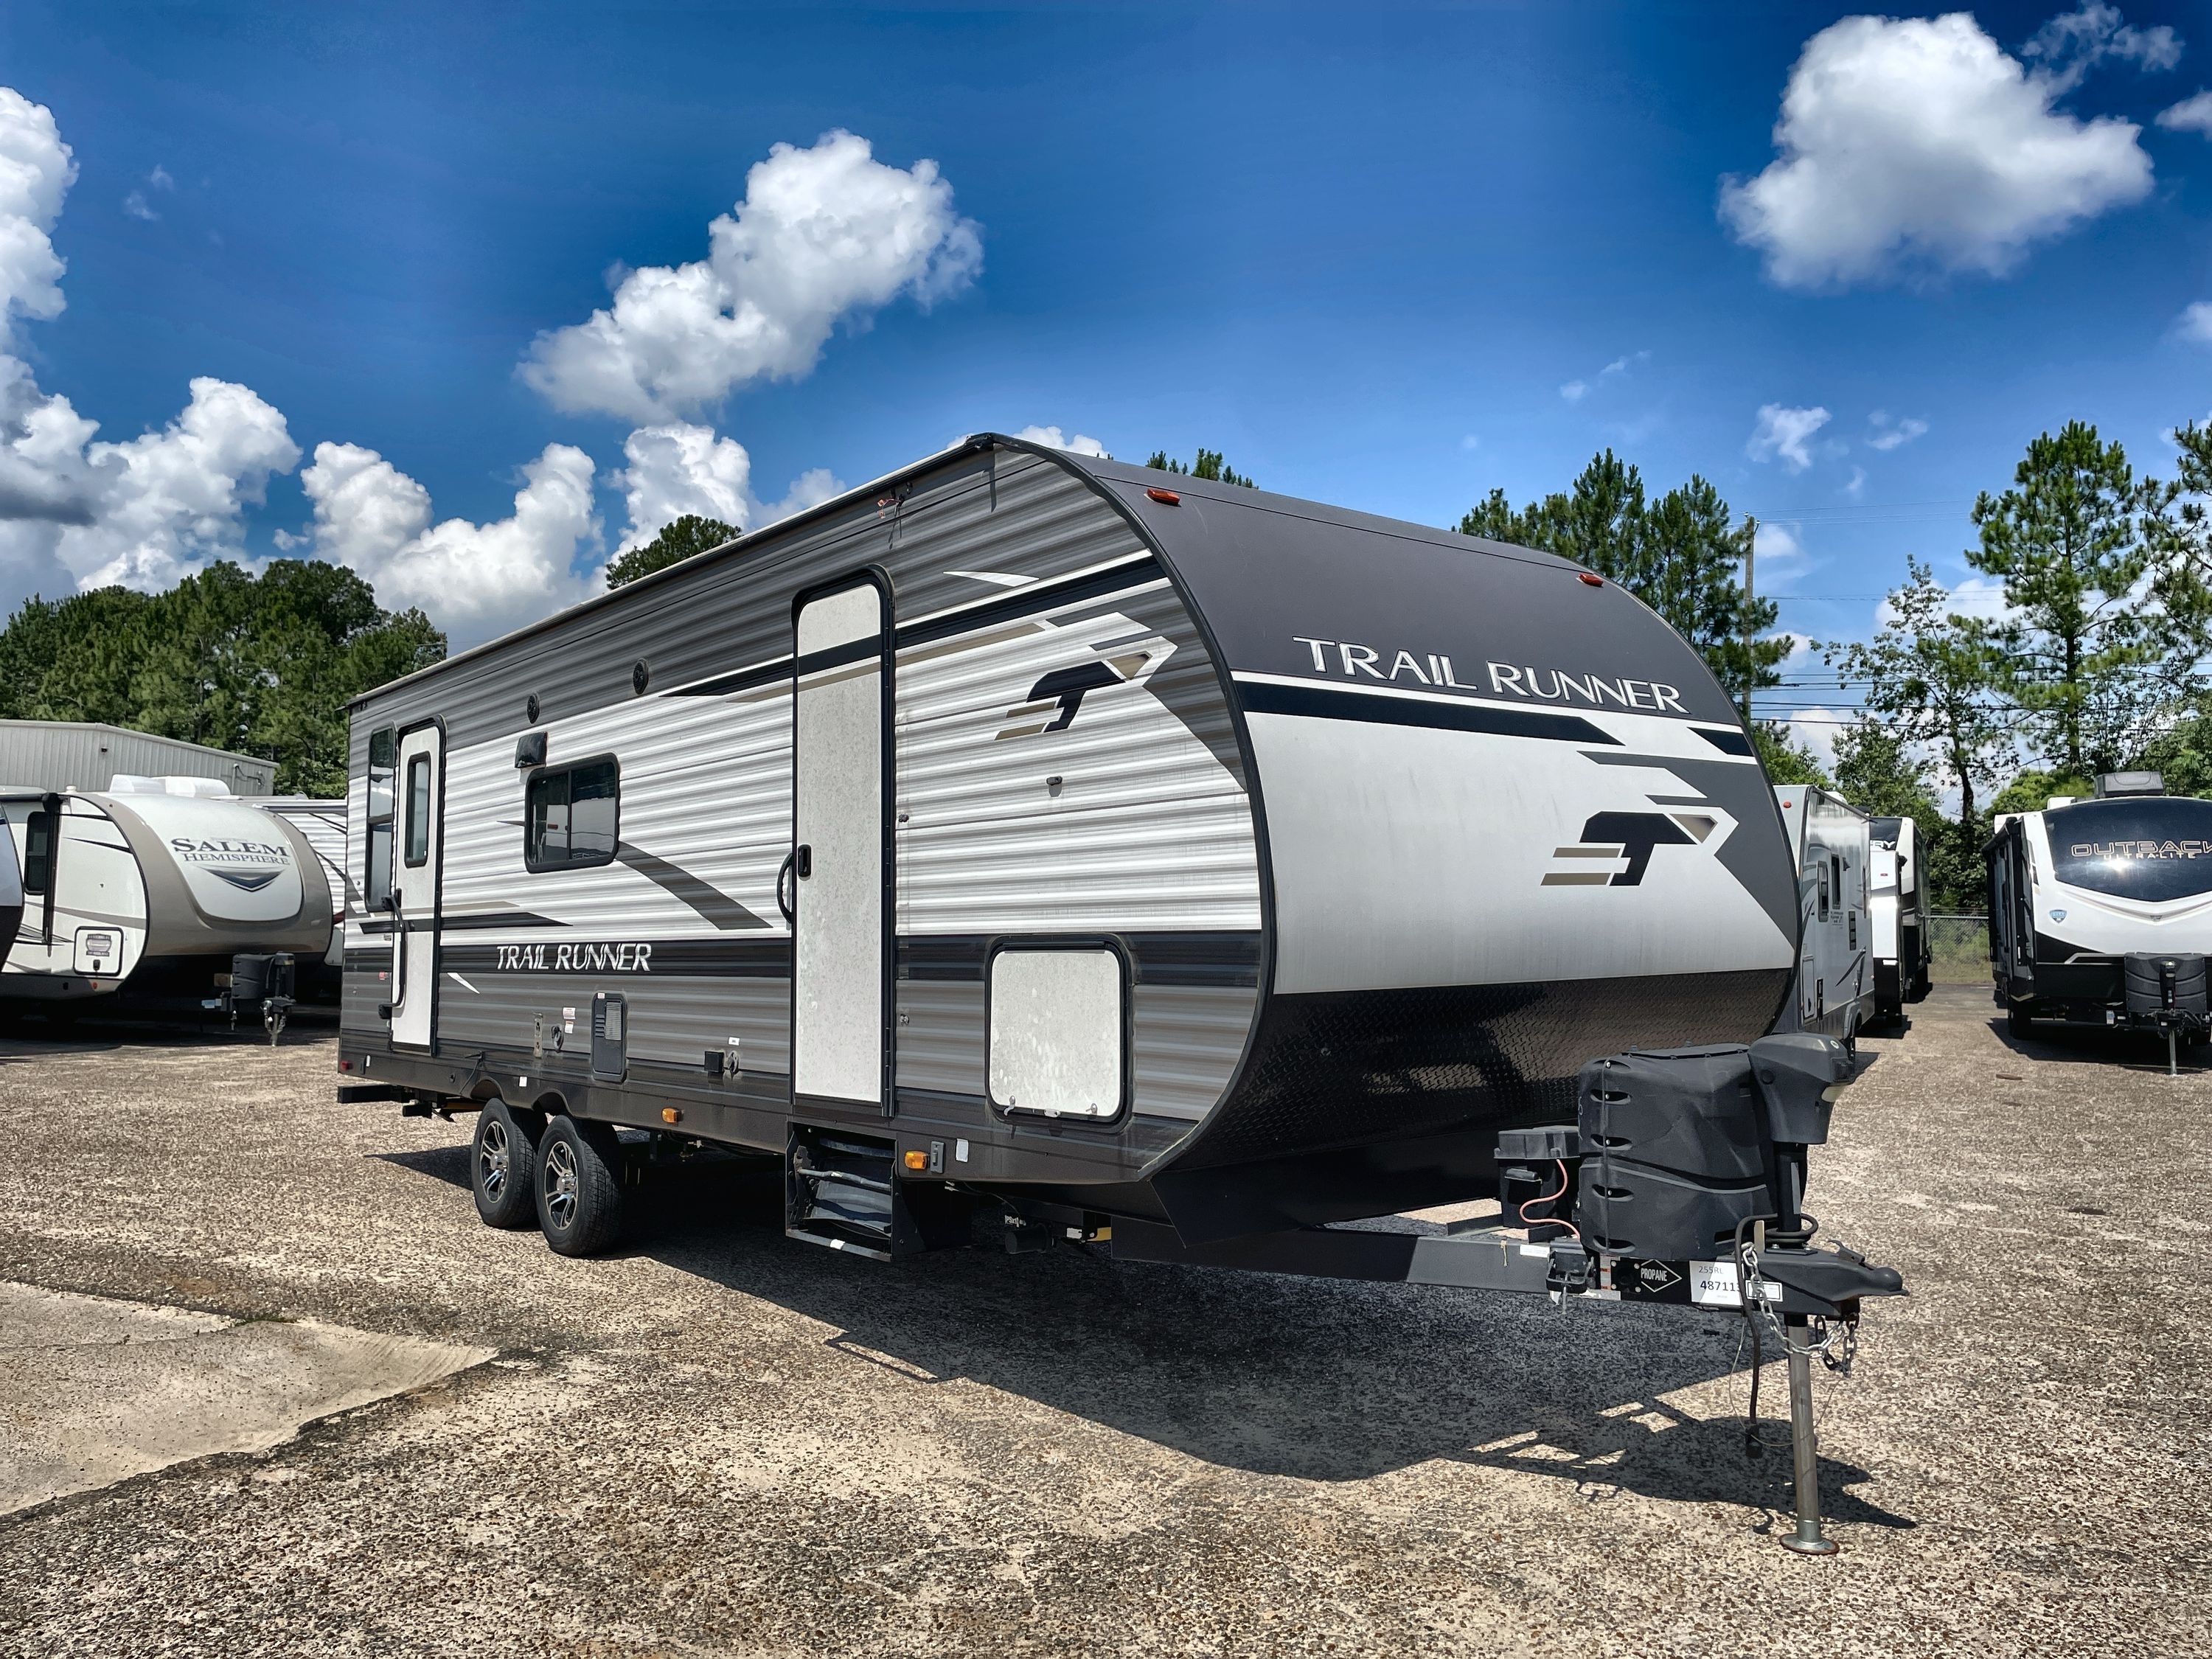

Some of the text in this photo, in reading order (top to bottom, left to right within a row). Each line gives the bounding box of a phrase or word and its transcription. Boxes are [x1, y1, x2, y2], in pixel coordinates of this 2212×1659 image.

[1292, 635, 1691, 714] TRAIL RUNNER
[170, 838, 291, 858] SALEM
[181, 853, 290, 866] HEMISPHERE
[496, 943, 652, 971] TRAIL RUNNER
[1641, 1267, 1668, 1282] PROPANE
[1698, 1265, 1725, 1275] 255RL
